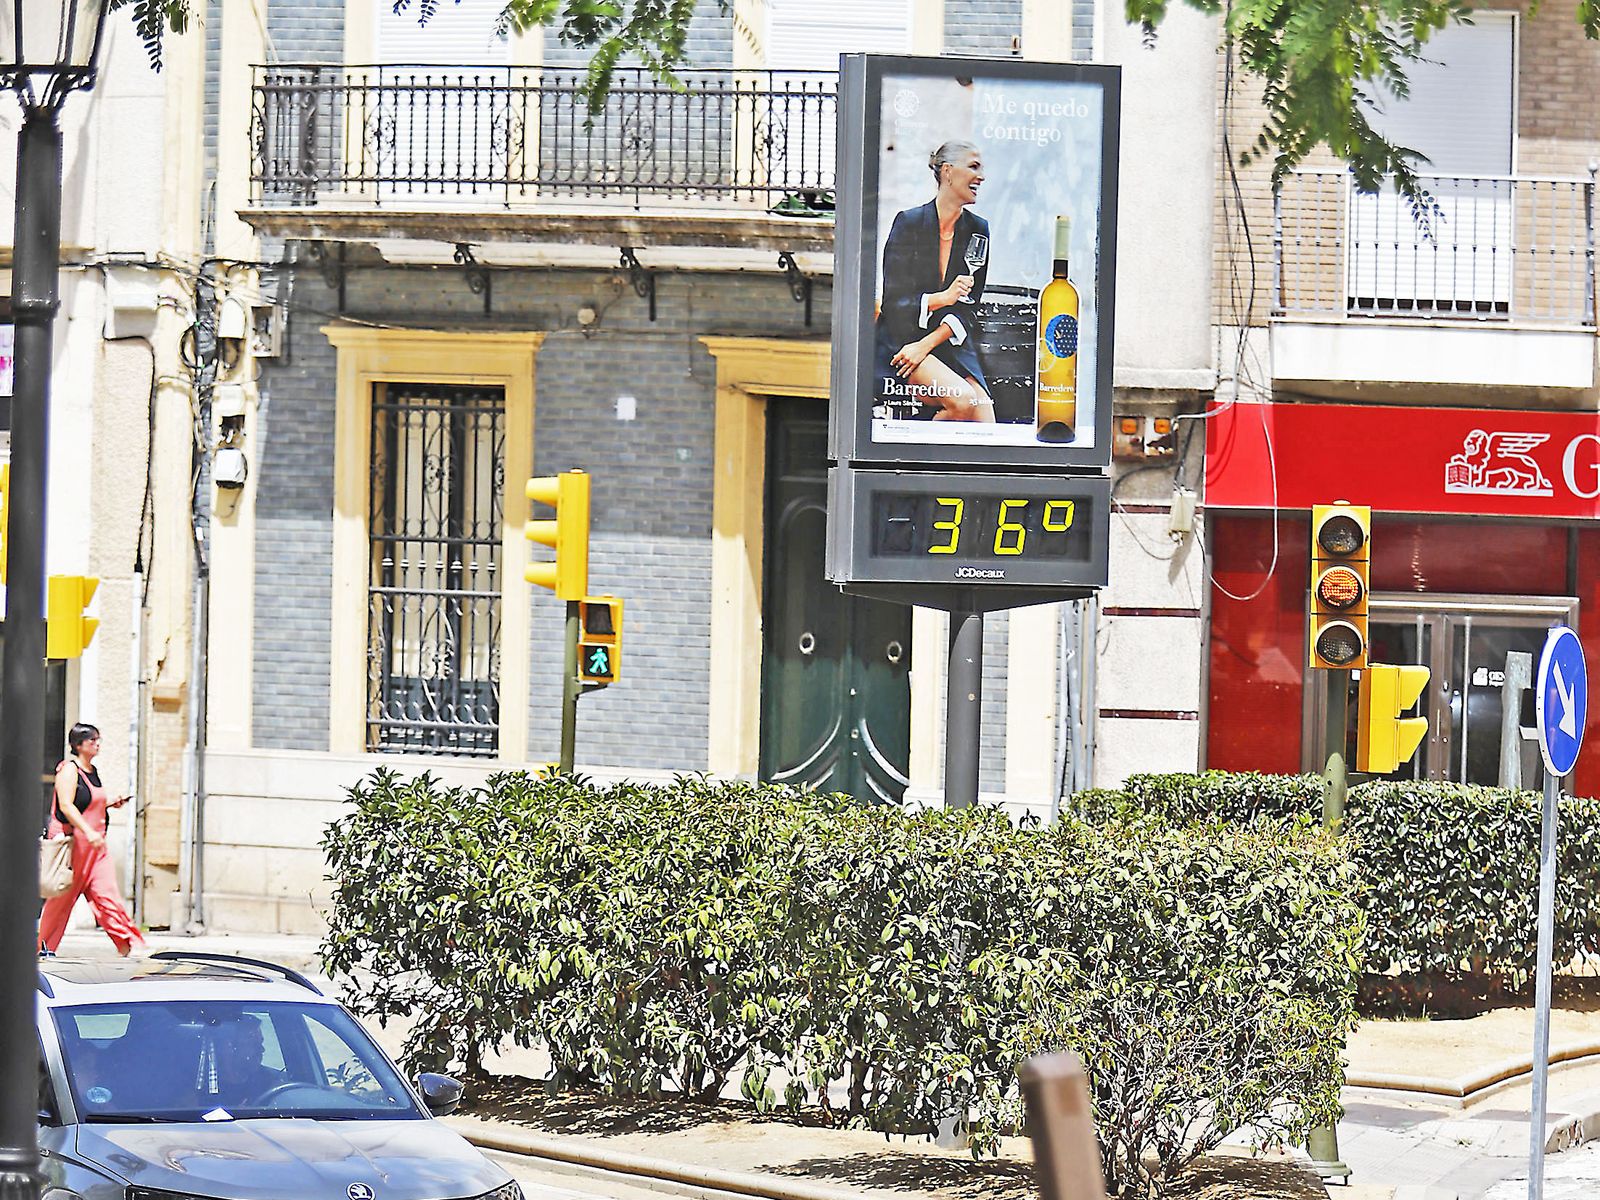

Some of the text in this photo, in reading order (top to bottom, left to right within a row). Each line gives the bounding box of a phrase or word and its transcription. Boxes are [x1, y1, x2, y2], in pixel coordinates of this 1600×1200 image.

[983, 94, 1089, 119] Me quedo
[982, 123, 1061, 147] contigo
[882, 377, 962, 398] Barredero
[1562, 434, 1600, 499] G
[955, 567, 1005, 578] JCDecaux
